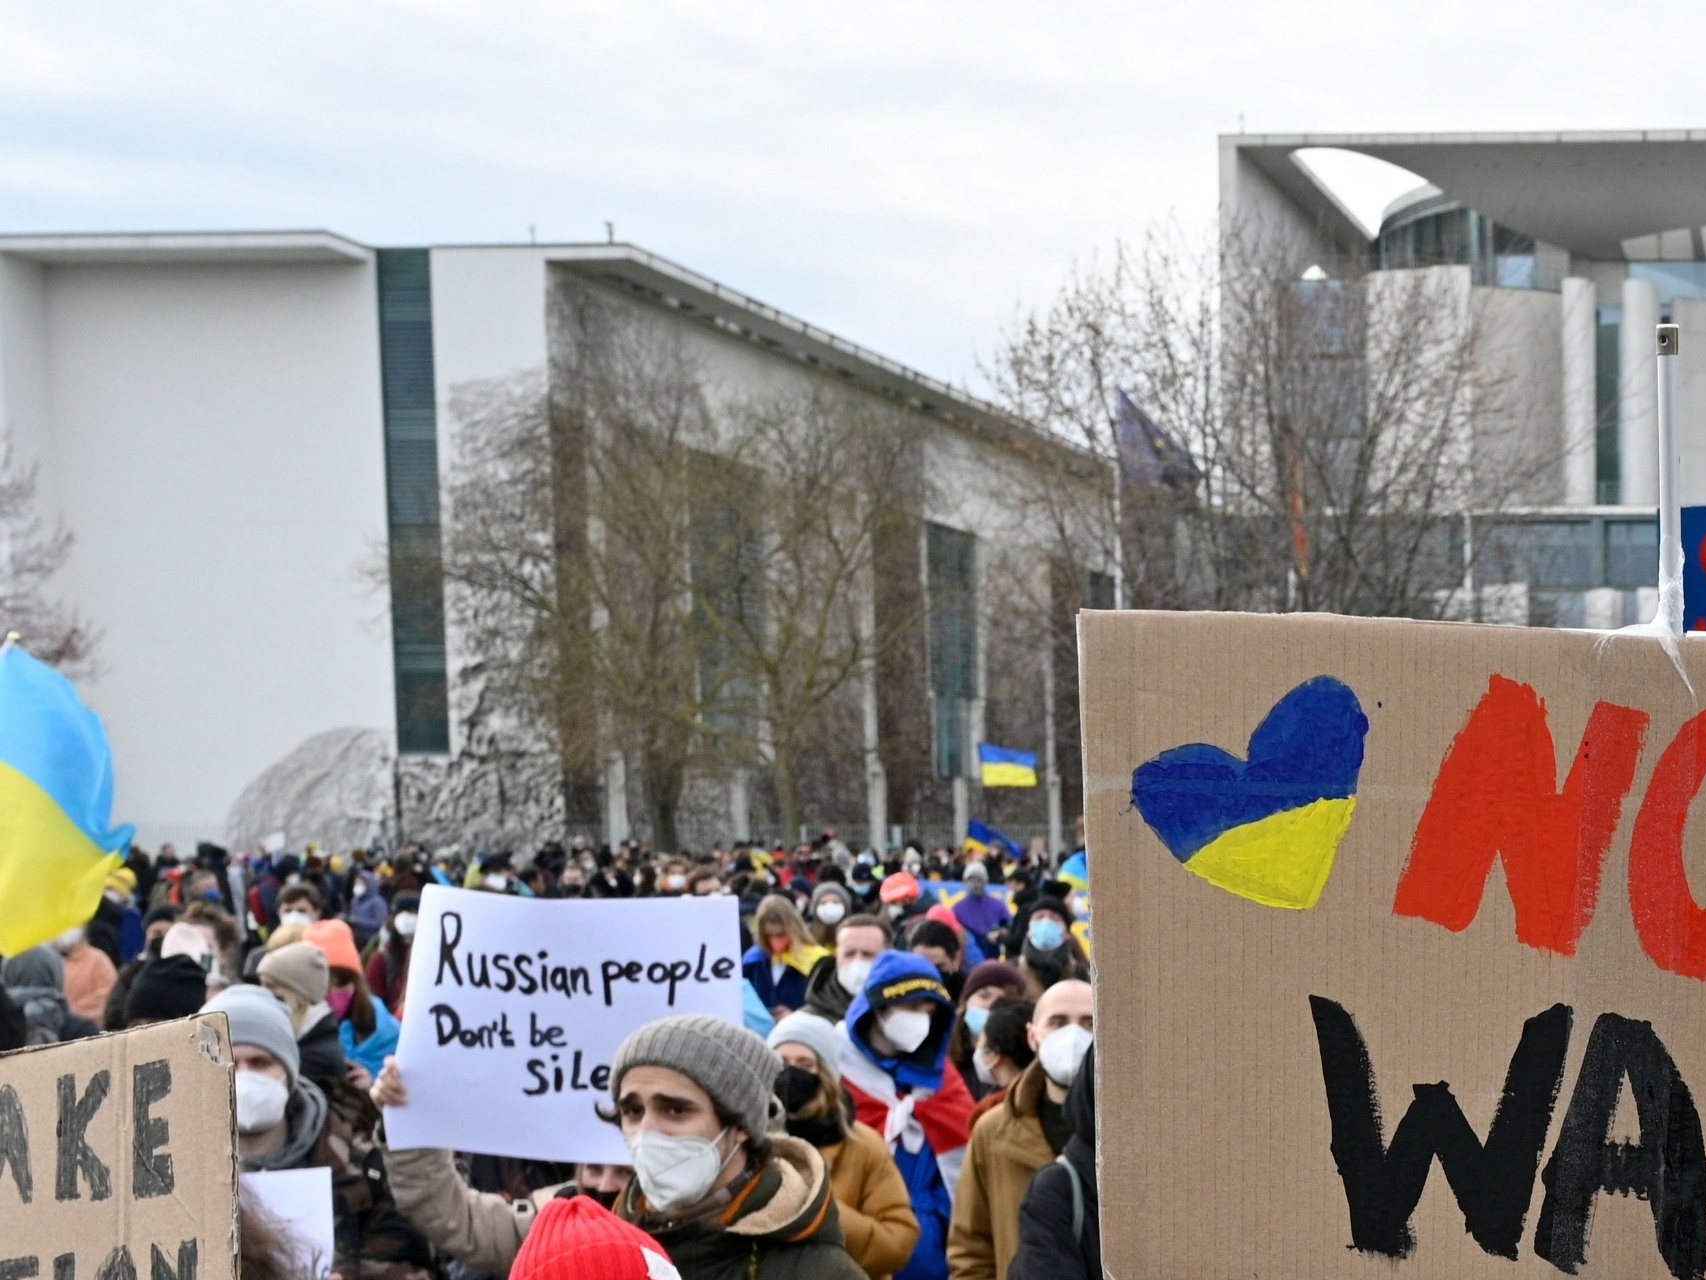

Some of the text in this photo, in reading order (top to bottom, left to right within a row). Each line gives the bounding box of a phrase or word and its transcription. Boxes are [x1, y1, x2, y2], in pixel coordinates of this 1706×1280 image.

[435, 911, 735, 1006] Russian people
[429, 1003, 567, 1048] Don't be
[0, 1059, 175, 1204] AKE
